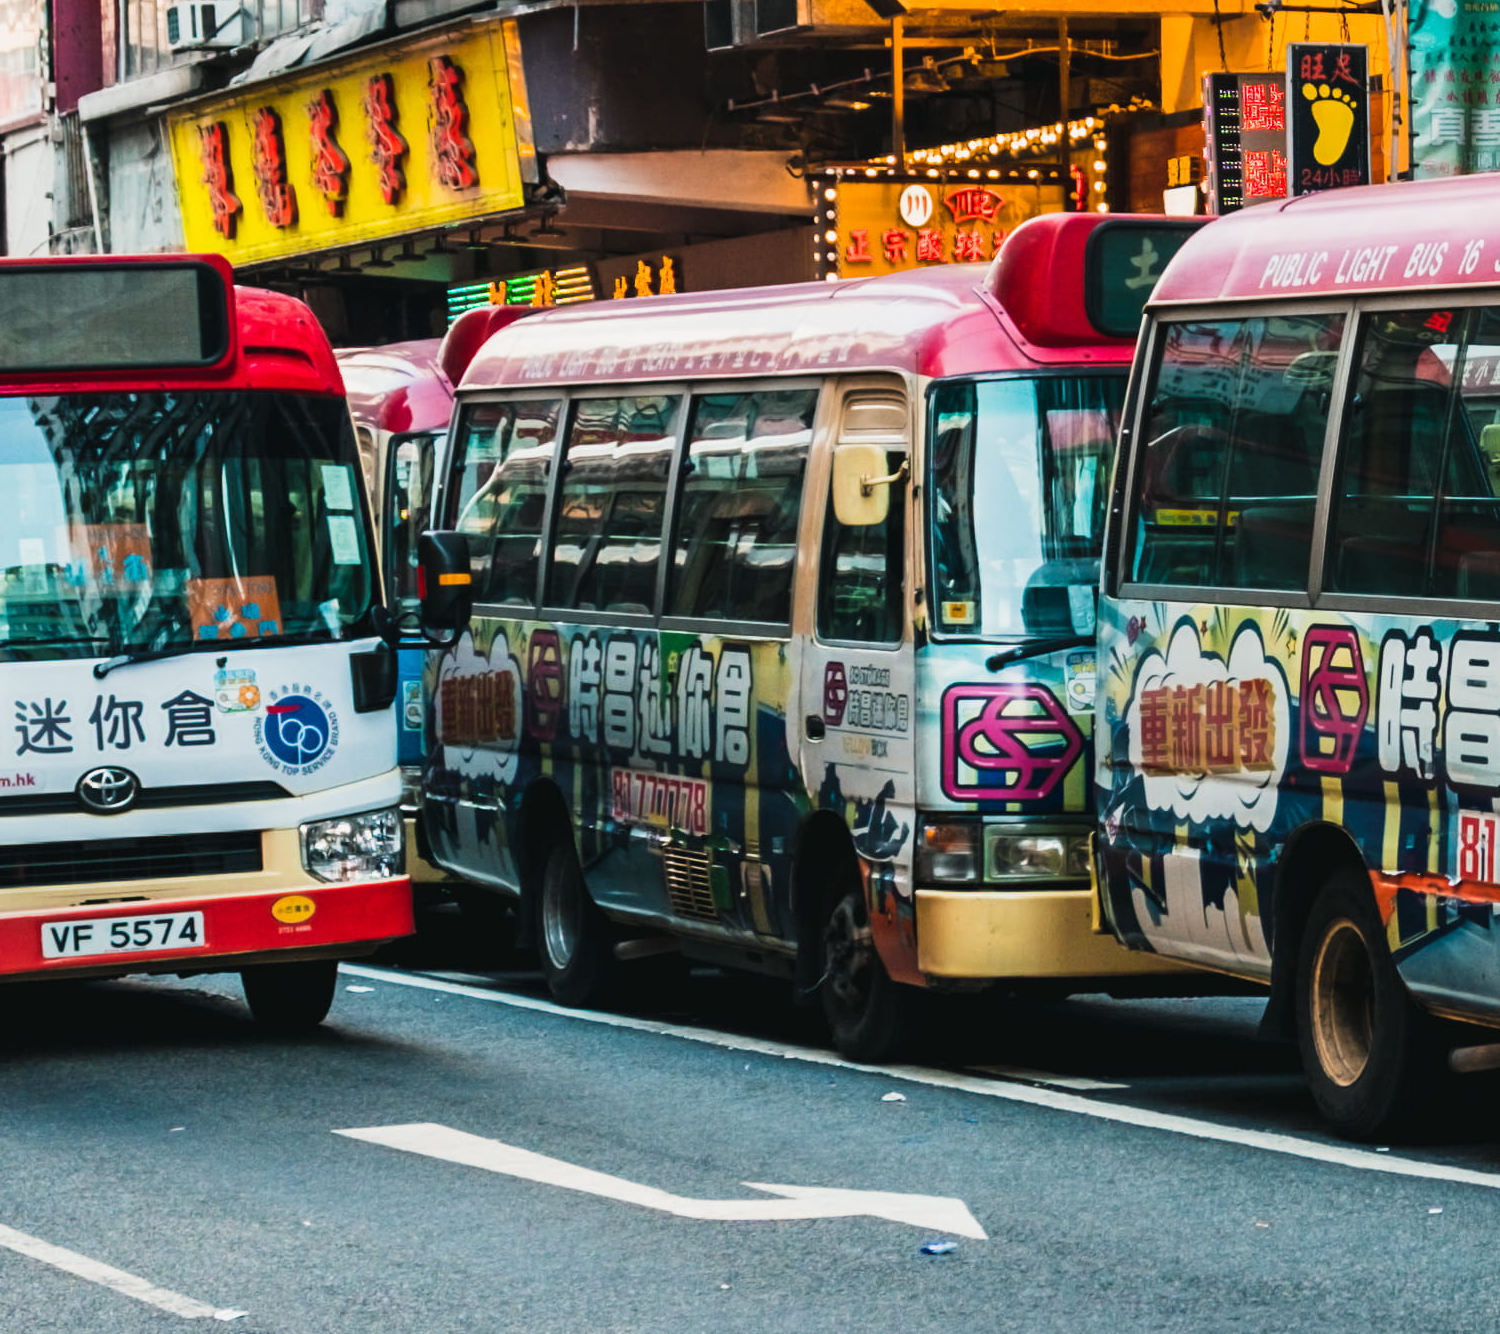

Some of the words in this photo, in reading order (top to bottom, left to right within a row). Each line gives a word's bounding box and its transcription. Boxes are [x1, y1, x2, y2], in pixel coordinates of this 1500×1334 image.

[1258, 253, 1320, 289] PUBLIC
[1333, 246, 1396, 284] LIGHT
[1404, 242, 1449, 278] BUS
[1456, 242, 1481, 273] 16
[51, 926, 93, 953] VF
[111, 917, 197, 949] 5574
